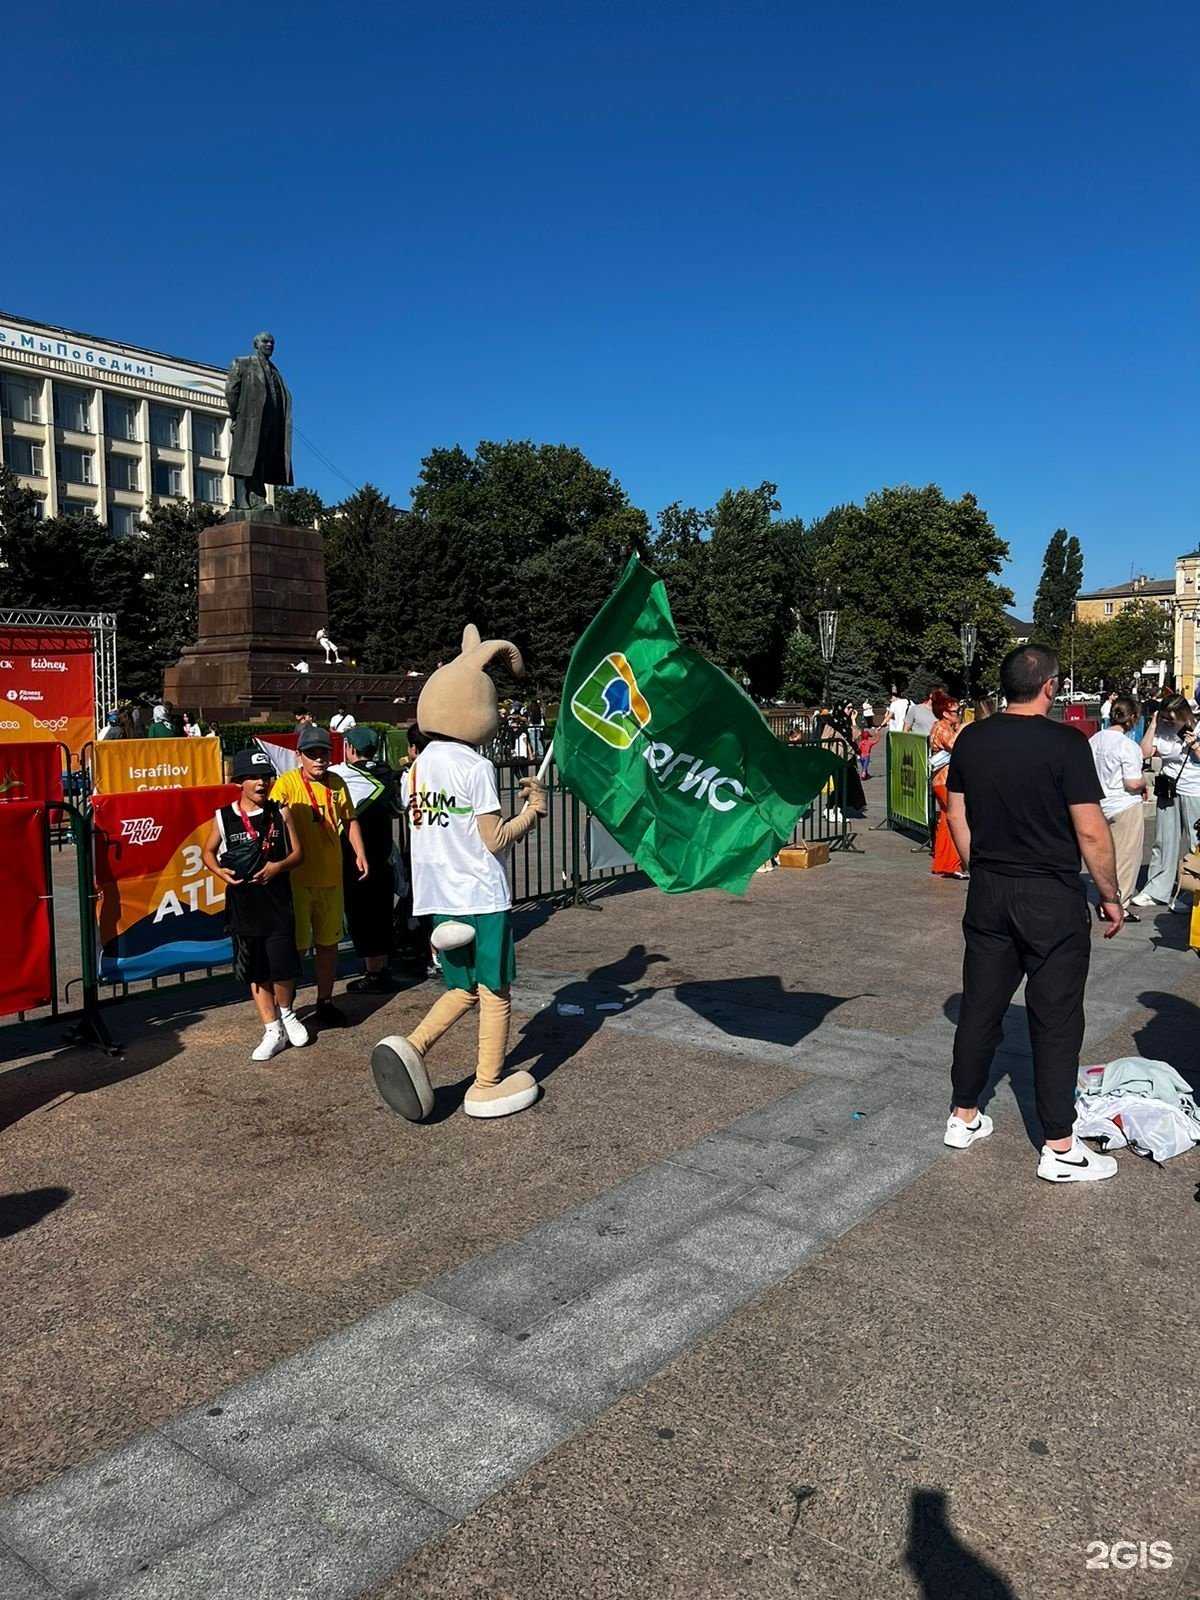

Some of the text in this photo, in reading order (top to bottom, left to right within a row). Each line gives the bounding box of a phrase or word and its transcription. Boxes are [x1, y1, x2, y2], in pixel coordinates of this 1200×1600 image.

[31, 657, 68, 672] kidney
[128, 763, 189, 779] Israfilov
[122, 817, 154, 834] DAG
[130, 826, 162, 844] RUN
